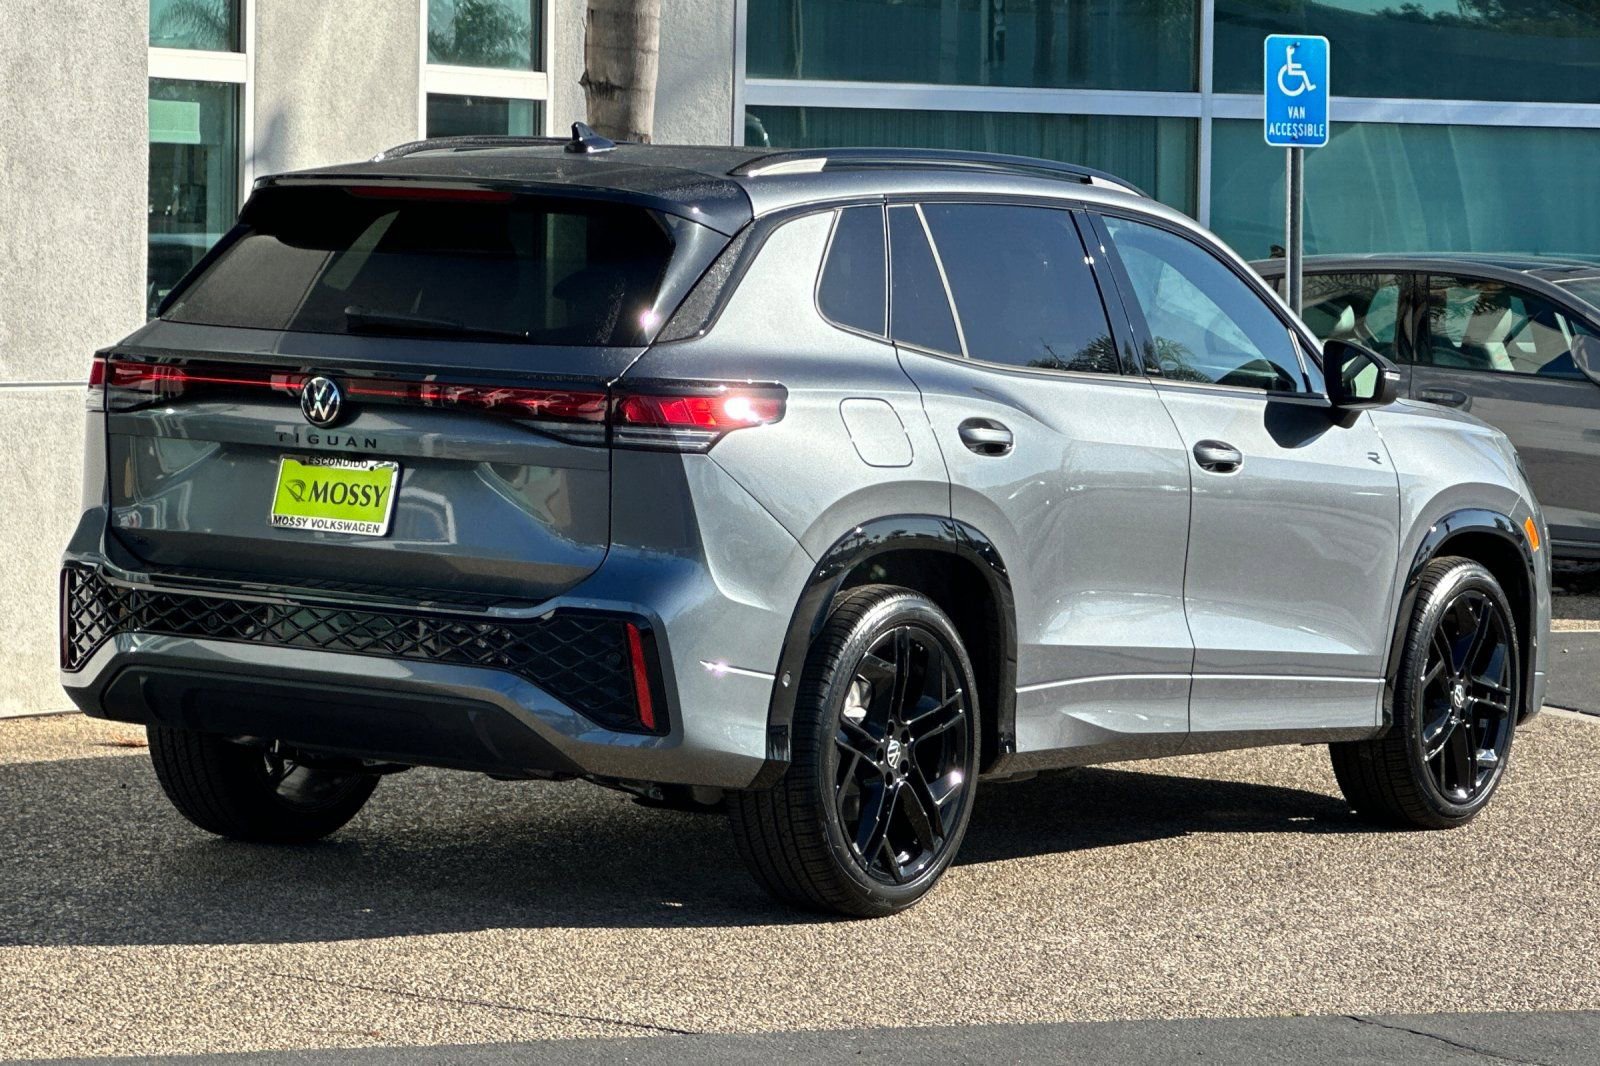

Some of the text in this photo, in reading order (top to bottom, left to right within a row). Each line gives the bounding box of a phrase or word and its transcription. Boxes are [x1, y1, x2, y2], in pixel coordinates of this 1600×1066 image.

[1287, 105, 1306, 119] VAN
[1268, 122, 1325, 137] ACCESSIBLE
[276, 432, 378, 449] TIGUAN
[308, 456, 368, 469] ESCONDIDO
[308, 480, 387, 508] MOSSY
[273, 515, 380, 534] MOSSY VOLKSWAGEN
